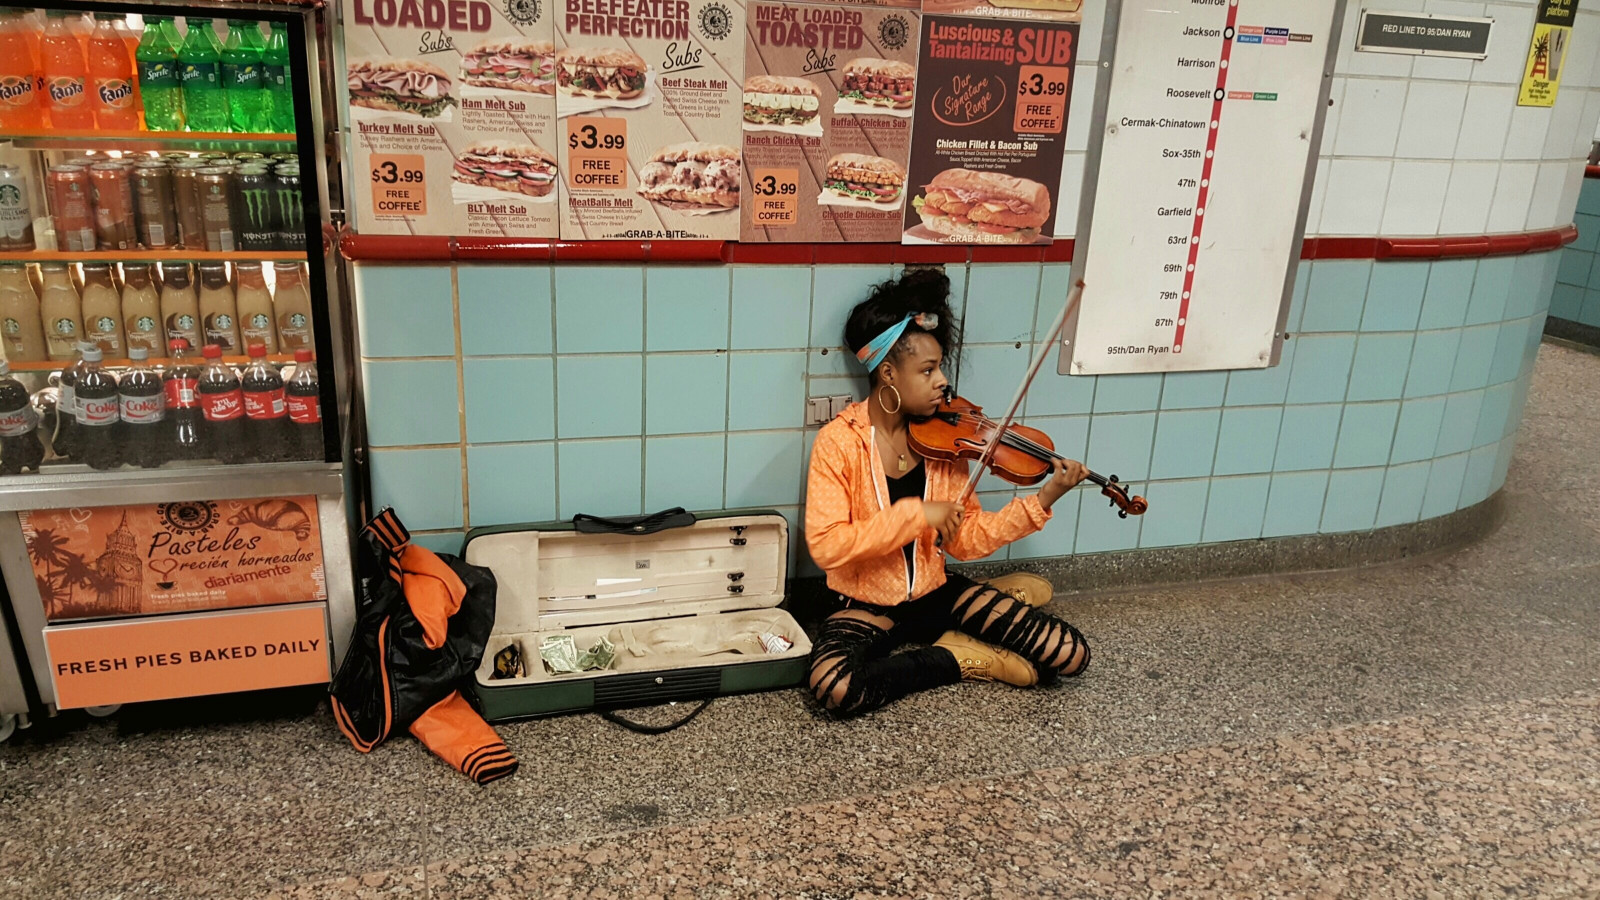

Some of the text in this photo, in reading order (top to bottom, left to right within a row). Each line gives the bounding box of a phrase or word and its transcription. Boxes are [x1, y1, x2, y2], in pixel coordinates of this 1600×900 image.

[354, 0, 492, 32] LOADED
[566, 0, 690, 20] BEEFEATER
[756, 6, 863, 25] MEAT LOADED
[975, 6, 1032, 18] GRAB-A-BITE
[1546, 6, 1569, 17] platform
[566, 14, 689, 40] PERFECTION
[1182, 26, 1220, 38] Jackson
[1382, 24, 1398, 32] RED
[1399, 26, 1416, 34] LINE
[1416, 26, 1426, 35] TO
[1452, 30, 1472, 38] RYAN
[756, 20, 864, 50] TOASTED
[930, 21, 1014, 46] Luscious &
[419, 30, 453, 53] Subs
[1016, 28, 1072, 64] SUB
[662, 40, 702, 70] Subs
[929, 40, 1015, 66] Tantalizing
[802, 48, 836, 72] Subs
[1177, 56, 1215, 68] Harrison
[148, 69, 168, 80] Sprite
[182, 70, 200, 80] Sprite
[237, 70, 257, 83] Sprite
[662, 78, 728, 90] Beef Steak Melt
[952, 74, 972, 95] Our
[1019, 74, 1065, 96] $3.99
[1533, 80, 1550, 89] Danger
[50, 82, 83, 101] Fanta
[99, 84, 132, 104] Fanta
[944, 78, 988, 116] Signature
[1166, 88, 1210, 98] Roosevelt
[462, 98, 526, 111] Ham Melt Sub
[965, 92, 992, 121] Range
[1026, 105, 1052, 116] FREE
[358, 122, 436, 134] Turkey Melt Sub
[831, 118, 906, 128] Buffalo Chicken Sub
[1121, 117, 1206, 128] Cermak-Chinatown
[569, 124, 625, 150] $3.99
[746, 135, 770, 144] Ranch
[772, 136, 804, 145] Chicken
[806, 136, 820, 146] Sub
[936, 138, 1038, 150] Chicken Fillet & Bacon Sub
[1162, 148, 1201, 158] Sox-35th
[582, 160, 610, 170] FREE
[372, 161, 424, 184] $3.99
[754, 176, 796, 196] $3.99
[1178, 178, 1196, 188] 47th
[386, 190, 410, 198] FREE
[569, 198, 633, 206] MeatBalls Melt
[764, 202, 786, 210] FREE
[468, 204, 526, 214] BLT Melt Sub
[856, 211, 886, 219] Chicken
[1157, 208, 1192, 216] Garfield
[626, 230, 686, 238] GRAB-A-BITE
[950, 234, 1003, 242] GRAB-A-BITE
[1168, 236, 1187, 244] 63rd
[1164, 264, 1182, 272] 69th
[1160, 292, 1178, 300] 79th
[1154, 318, 1174, 326] 87th
[1107, 346, 1168, 354] 95th/Dan Ryan
[86, 402, 117, 414] Coke
[126, 400, 157, 411] Coke
[148, 527, 262, 558] Pasteles
[179, 548, 314, 571] recién horneados
[204, 564, 291, 590] diariamente
[57, 639, 320, 676] FRESH PIES BAKED DAILY
